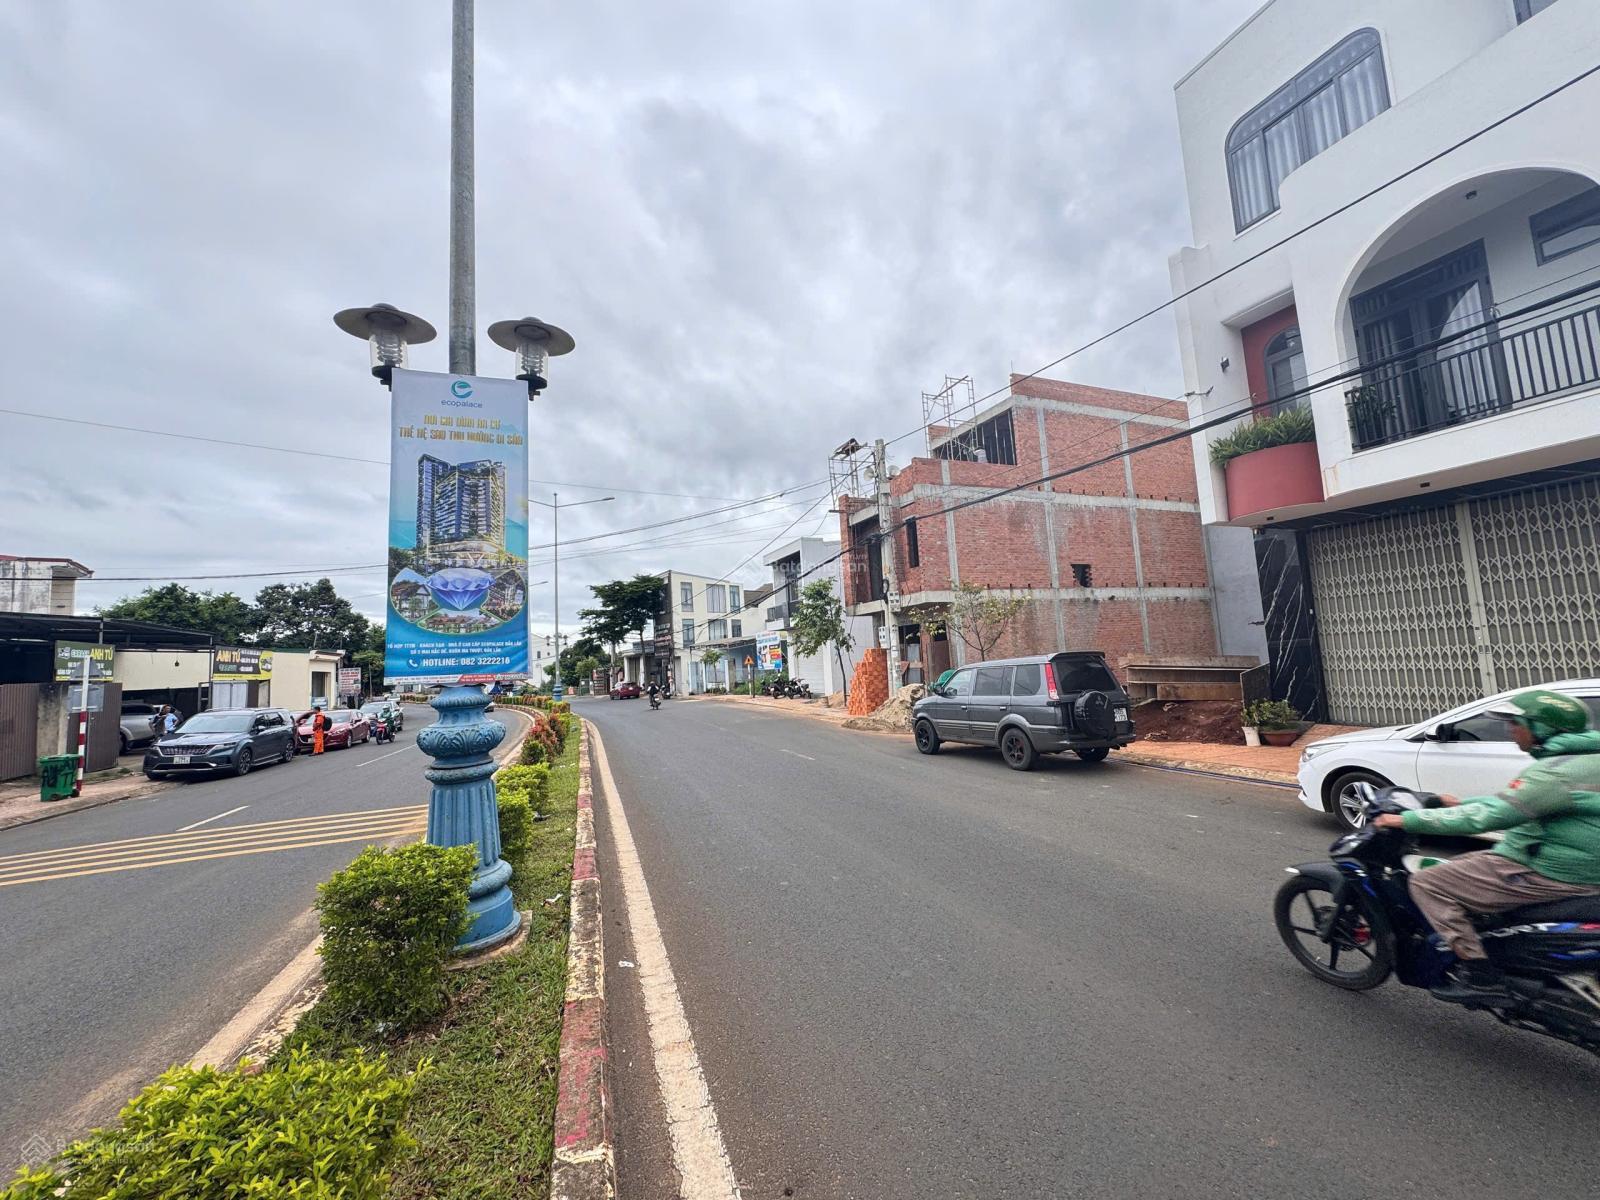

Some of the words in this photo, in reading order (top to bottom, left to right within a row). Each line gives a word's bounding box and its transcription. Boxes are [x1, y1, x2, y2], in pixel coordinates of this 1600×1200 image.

[441, 400, 482, 408] ecopalace
[422, 658, 459, 666] HOTLINE:
[460, 658, 476, 666] 082
